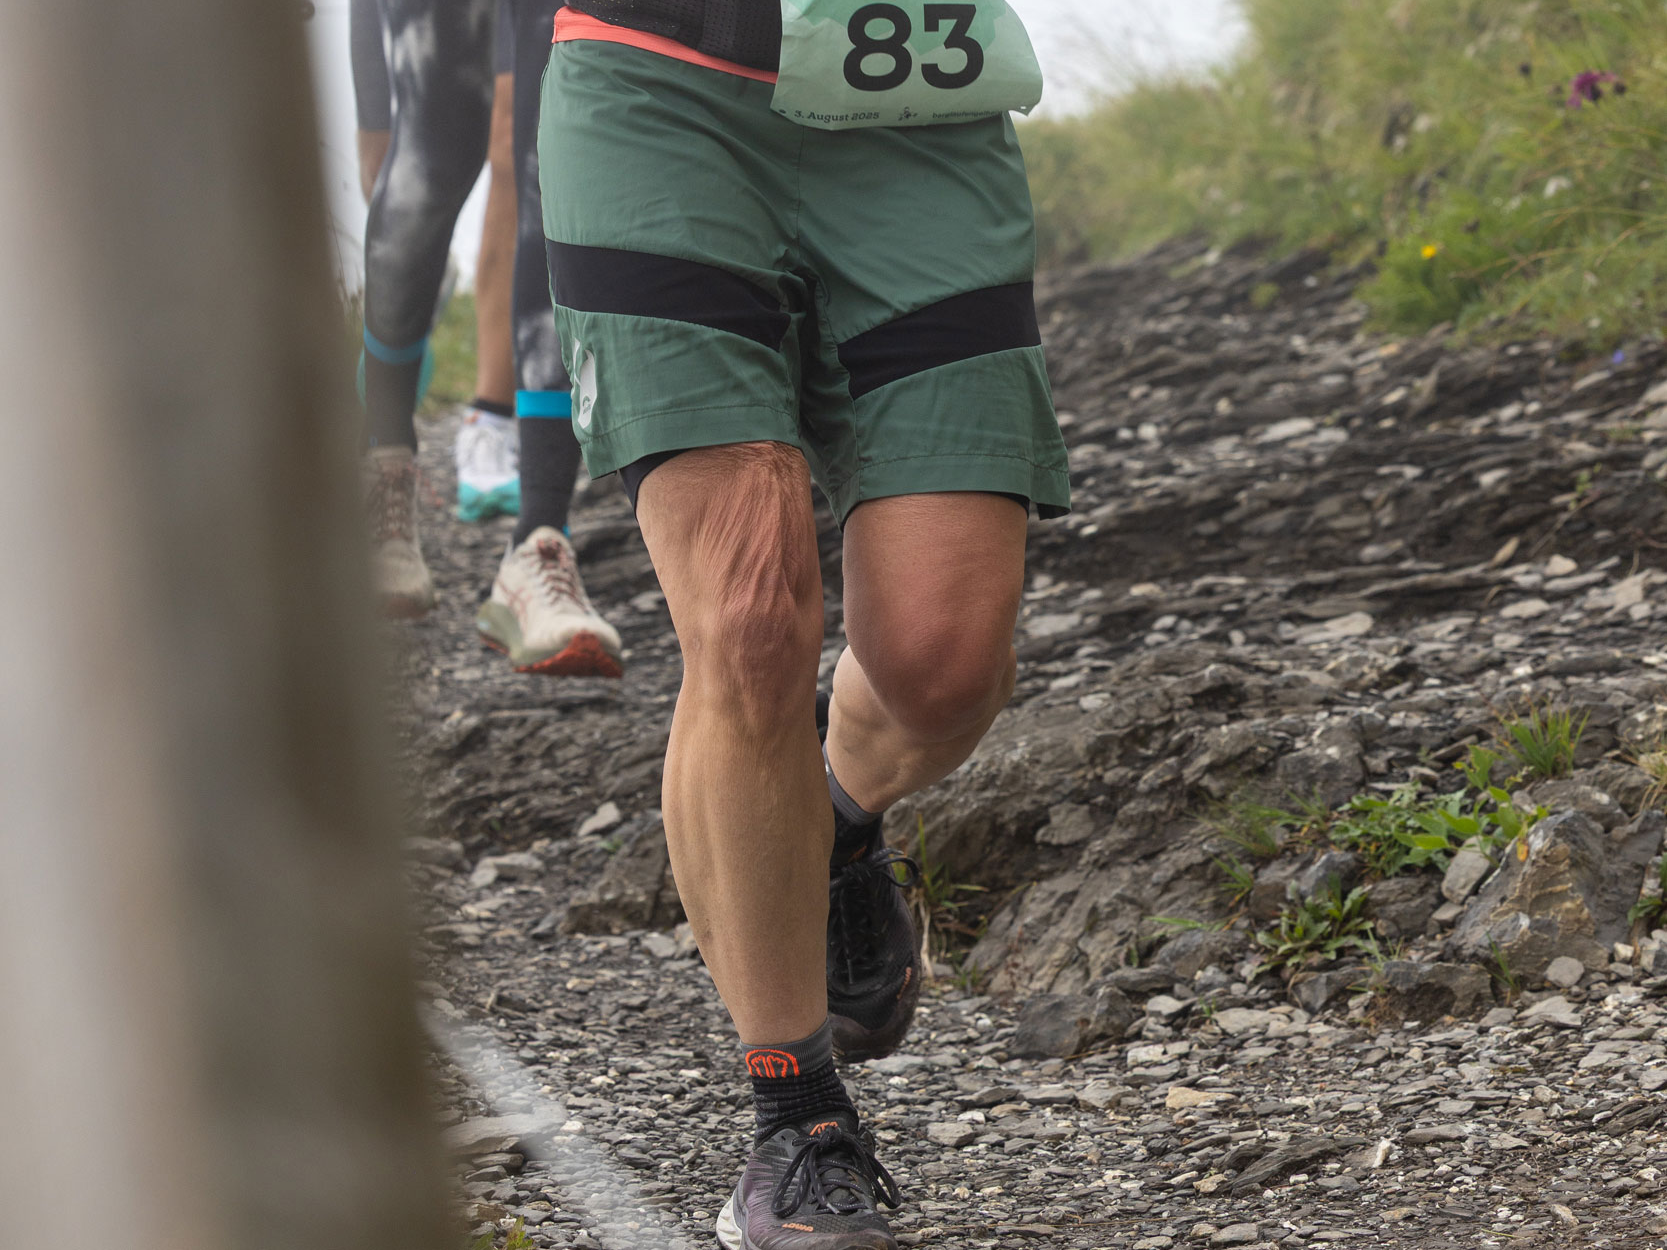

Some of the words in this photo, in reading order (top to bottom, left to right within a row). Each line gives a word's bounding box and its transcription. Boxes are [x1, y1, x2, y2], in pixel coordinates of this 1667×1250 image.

[843, 2, 984, 92] 83
[807, 111, 850, 123] August
[851, 111, 880, 121] 2025
